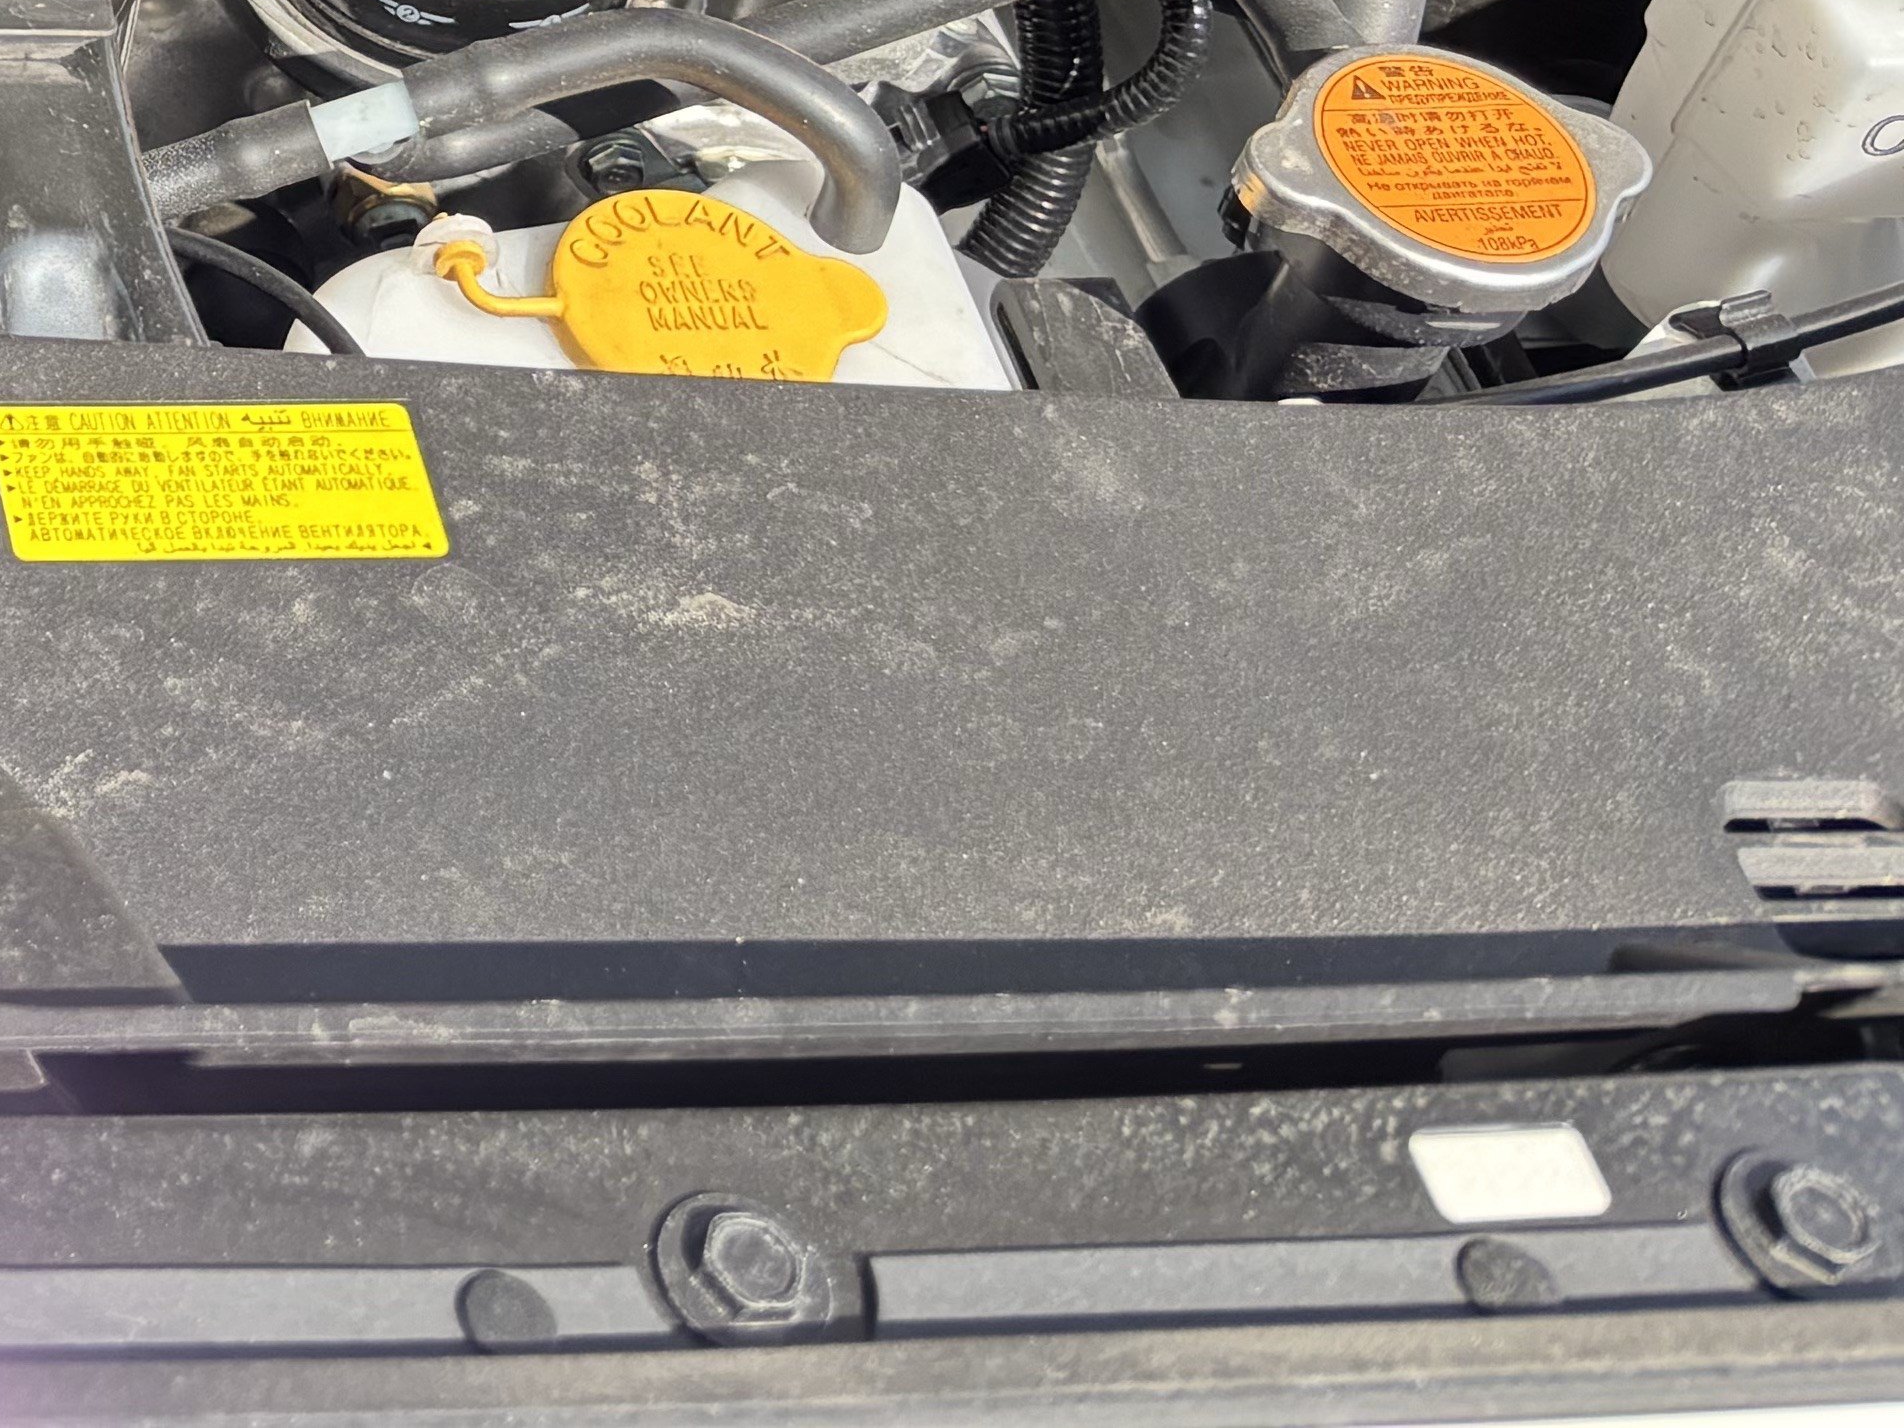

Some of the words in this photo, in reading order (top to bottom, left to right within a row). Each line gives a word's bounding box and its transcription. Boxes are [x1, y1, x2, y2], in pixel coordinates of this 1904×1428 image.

[1380, 76, 1480, 92] WARNING
[1342, 140, 1392, 153] NEVER
[1404, 138, 1451, 152] OPEN
[1455, 136, 1506, 150] WHEN
[1513, 133, 1552, 147] HOT.
[1351, 154, 1371, 167] NE
[1376, 153, 1428, 166] JAMAIS
[1432, 150, 1486, 164] OUVRIR
[1414, 204, 1564, 224] AVERTISSEMENT
[569, 196, 790, 269] COOLANT
[1478, 236, 1539, 252] 108kPa
[647, 252, 704, 278] SEE
[646, 305, 769, 332] MANUAL
[68, 412, 137, 431] CAUTION
[146, 411, 231, 430] ATTENTION
[300, 410, 390, 429] ВНИМАНИЕ
[15, 464, 50, 478] KEEP
[59, 464, 106, 478] HANDS
[167, 463, 196, 477] FAN
[203, 463, 259, 477] STARTS
[132, 479, 150, 493] DU
[156, 478, 255, 493] VENTILATEUR
[71, 494, 156, 509] APPROCHEZ
[164, 494, 194, 508] PAS
[203, 493, 233, 508] LES
